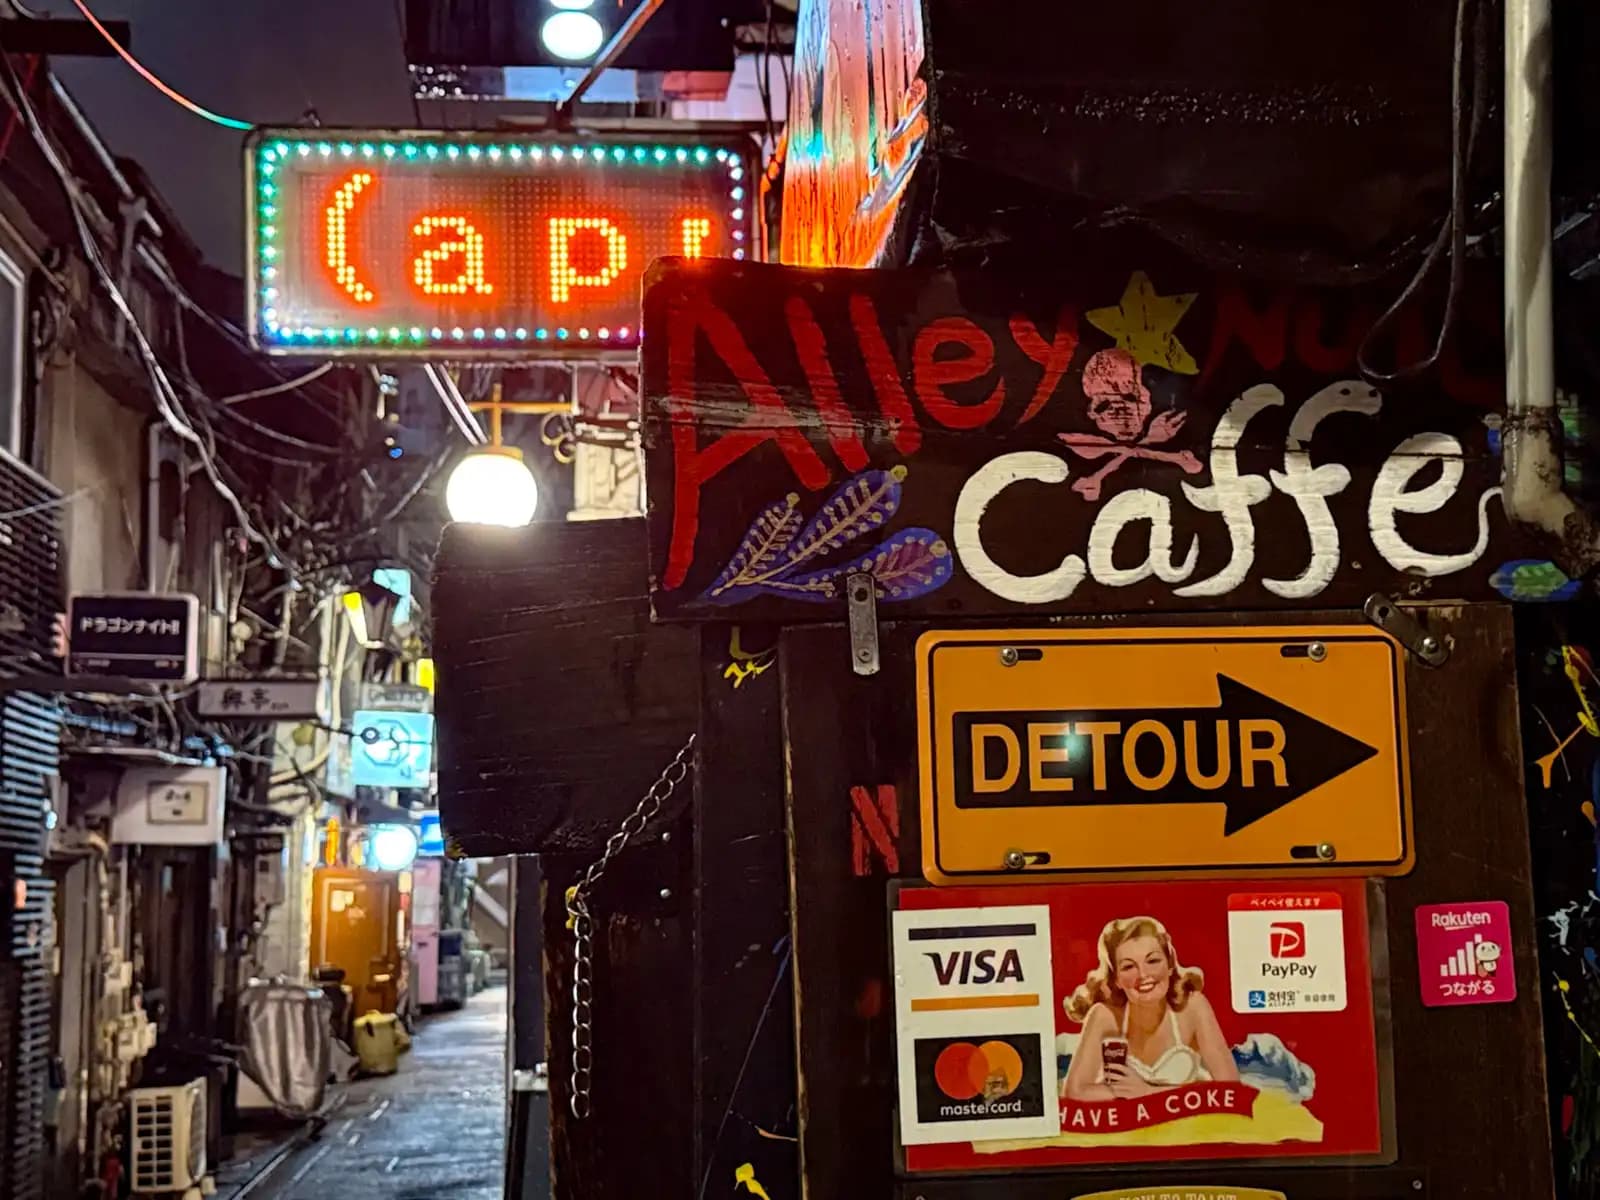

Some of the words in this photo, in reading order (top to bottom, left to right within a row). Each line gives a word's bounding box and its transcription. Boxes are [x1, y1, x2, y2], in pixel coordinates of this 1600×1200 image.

[662, 290, 1080, 592] Alley
[970, 718, 1289, 793] DETOUR
[850, 785, 899, 877] N
[1431, 911, 1491, 929] Rakuten
[922, 948, 1025, 985] VISA
[1262, 962, 1317, 979] PayPay
[1439, 979, 1496, 997] つながる
[940, 1099, 1022, 1117] mastercard
[1136, 1103, 1150, 1121] A
[1165, 1089, 1235, 1113] COKE
